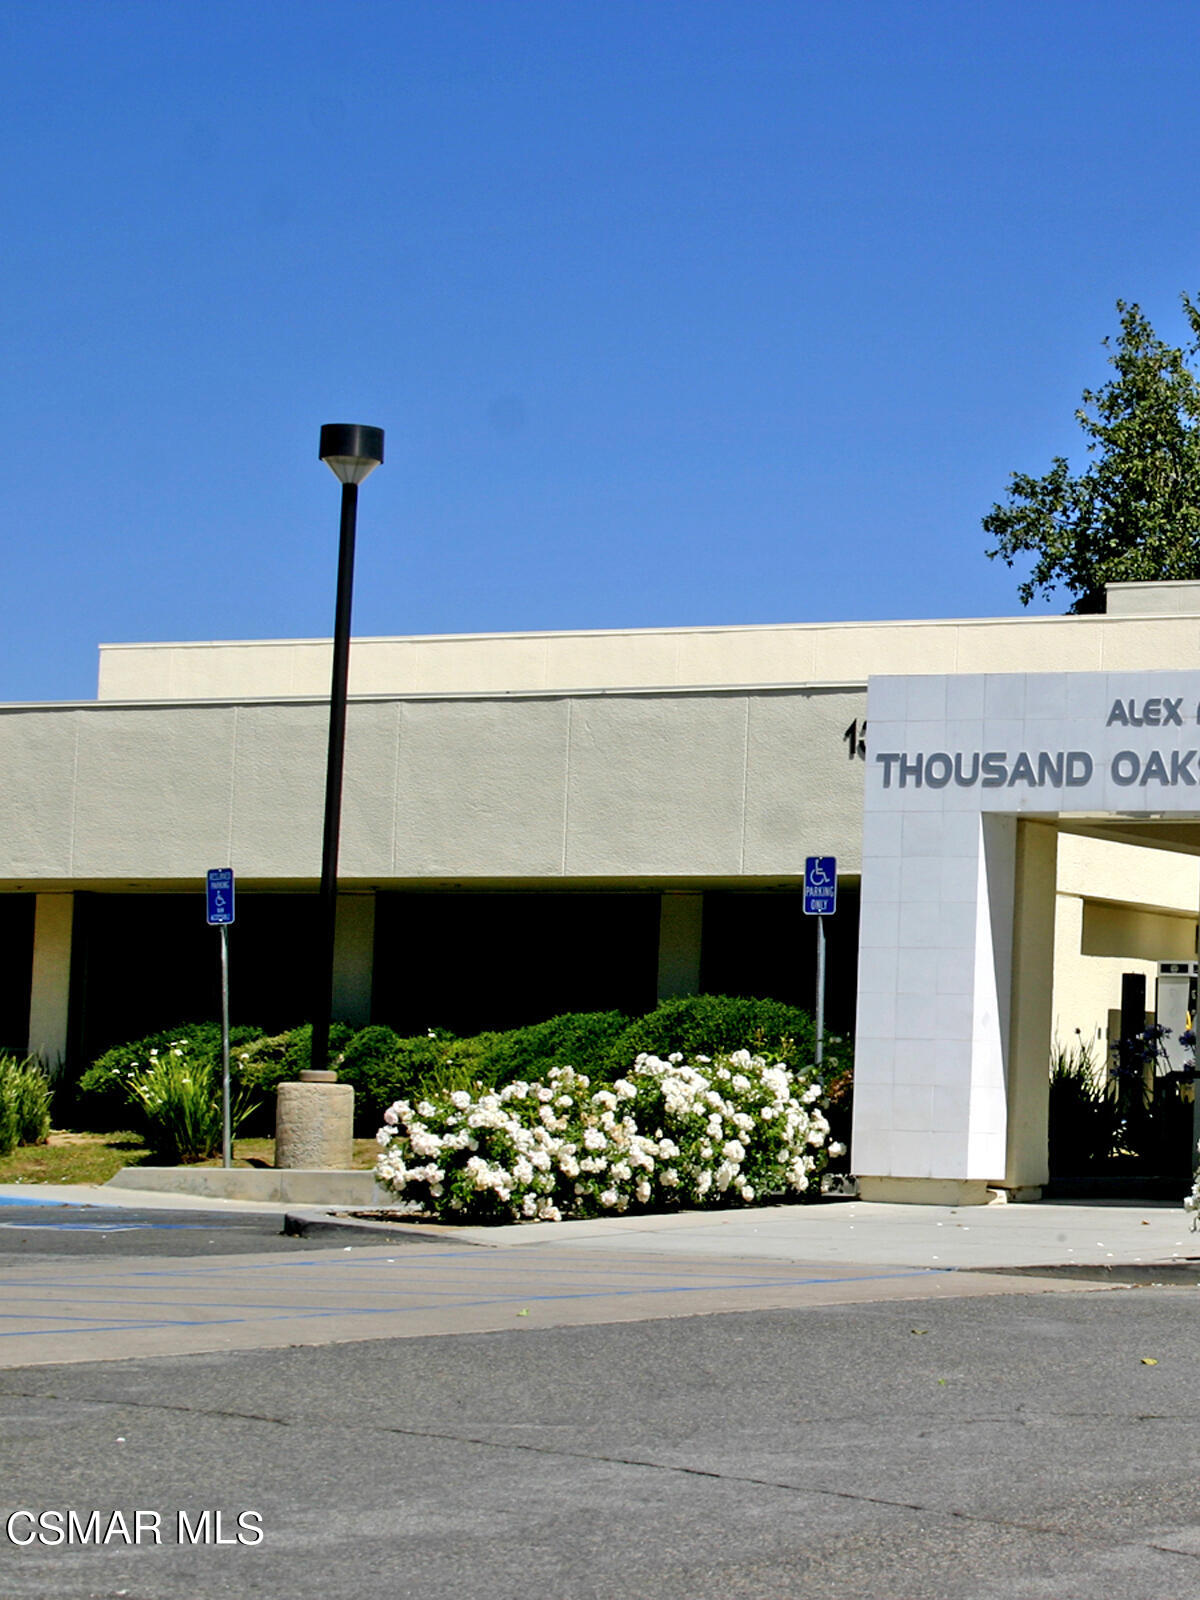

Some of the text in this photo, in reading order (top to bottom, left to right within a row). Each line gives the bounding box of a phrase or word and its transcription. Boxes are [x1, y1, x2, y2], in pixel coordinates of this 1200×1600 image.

[1106, 698, 1184, 727] ALEX
[876, 751, 1094, 788] THOUSAND
[805, 886, 834, 897] PARKING
[810, 899, 829, 911] ONLY
